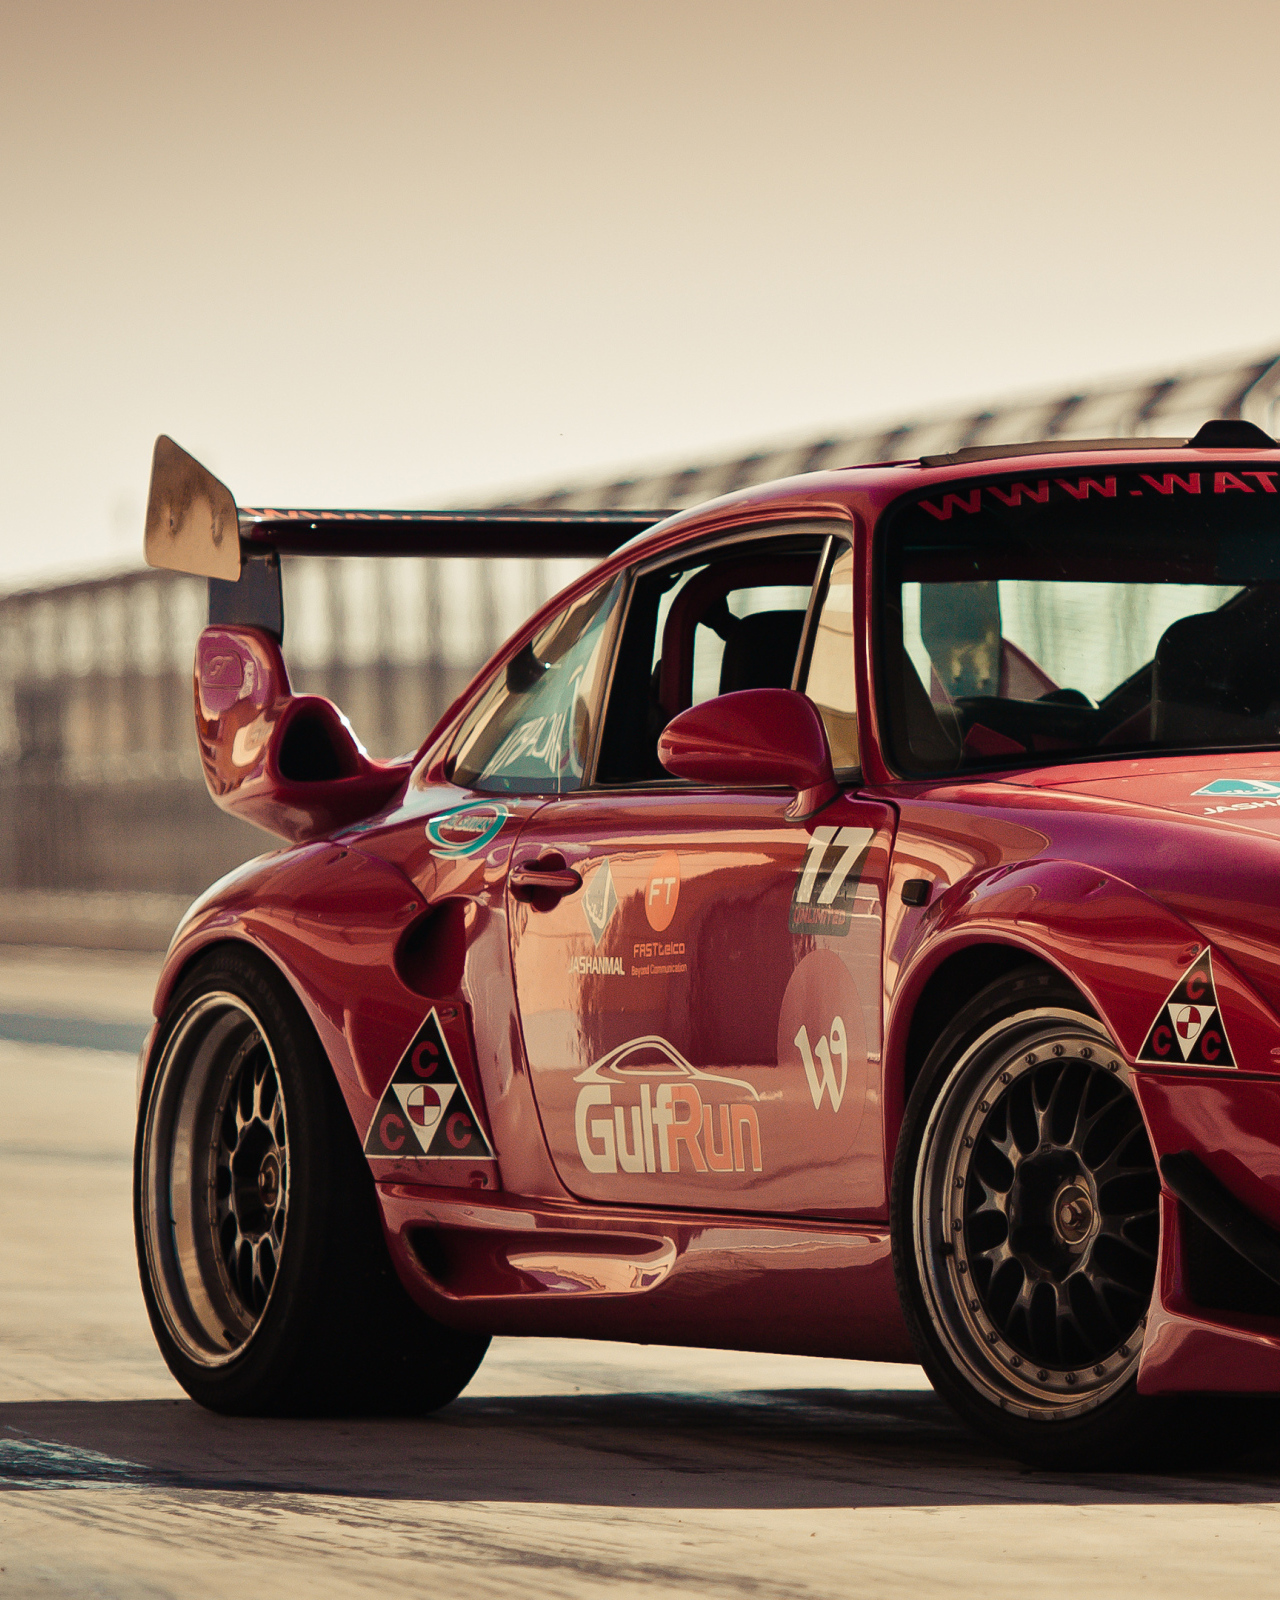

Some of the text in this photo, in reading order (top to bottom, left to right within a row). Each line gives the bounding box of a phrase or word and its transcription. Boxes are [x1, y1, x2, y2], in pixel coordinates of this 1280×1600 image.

[796, 826, 874, 904] 17
[649, 877, 676, 906] FT
[568, 955, 625, 975] JASHANMAL
[633, 942, 686, 958] FASTtelco
[631, 962, 688, 978] Beyond Communication
[1186, 970, 1208, 1000] C
[411, 1041, 439, 1078] C
[1152, 1025, 1221, 1061] C C
[379, 1111, 472, 1151] C C
[575, 1083, 762, 1173] GulfRun
